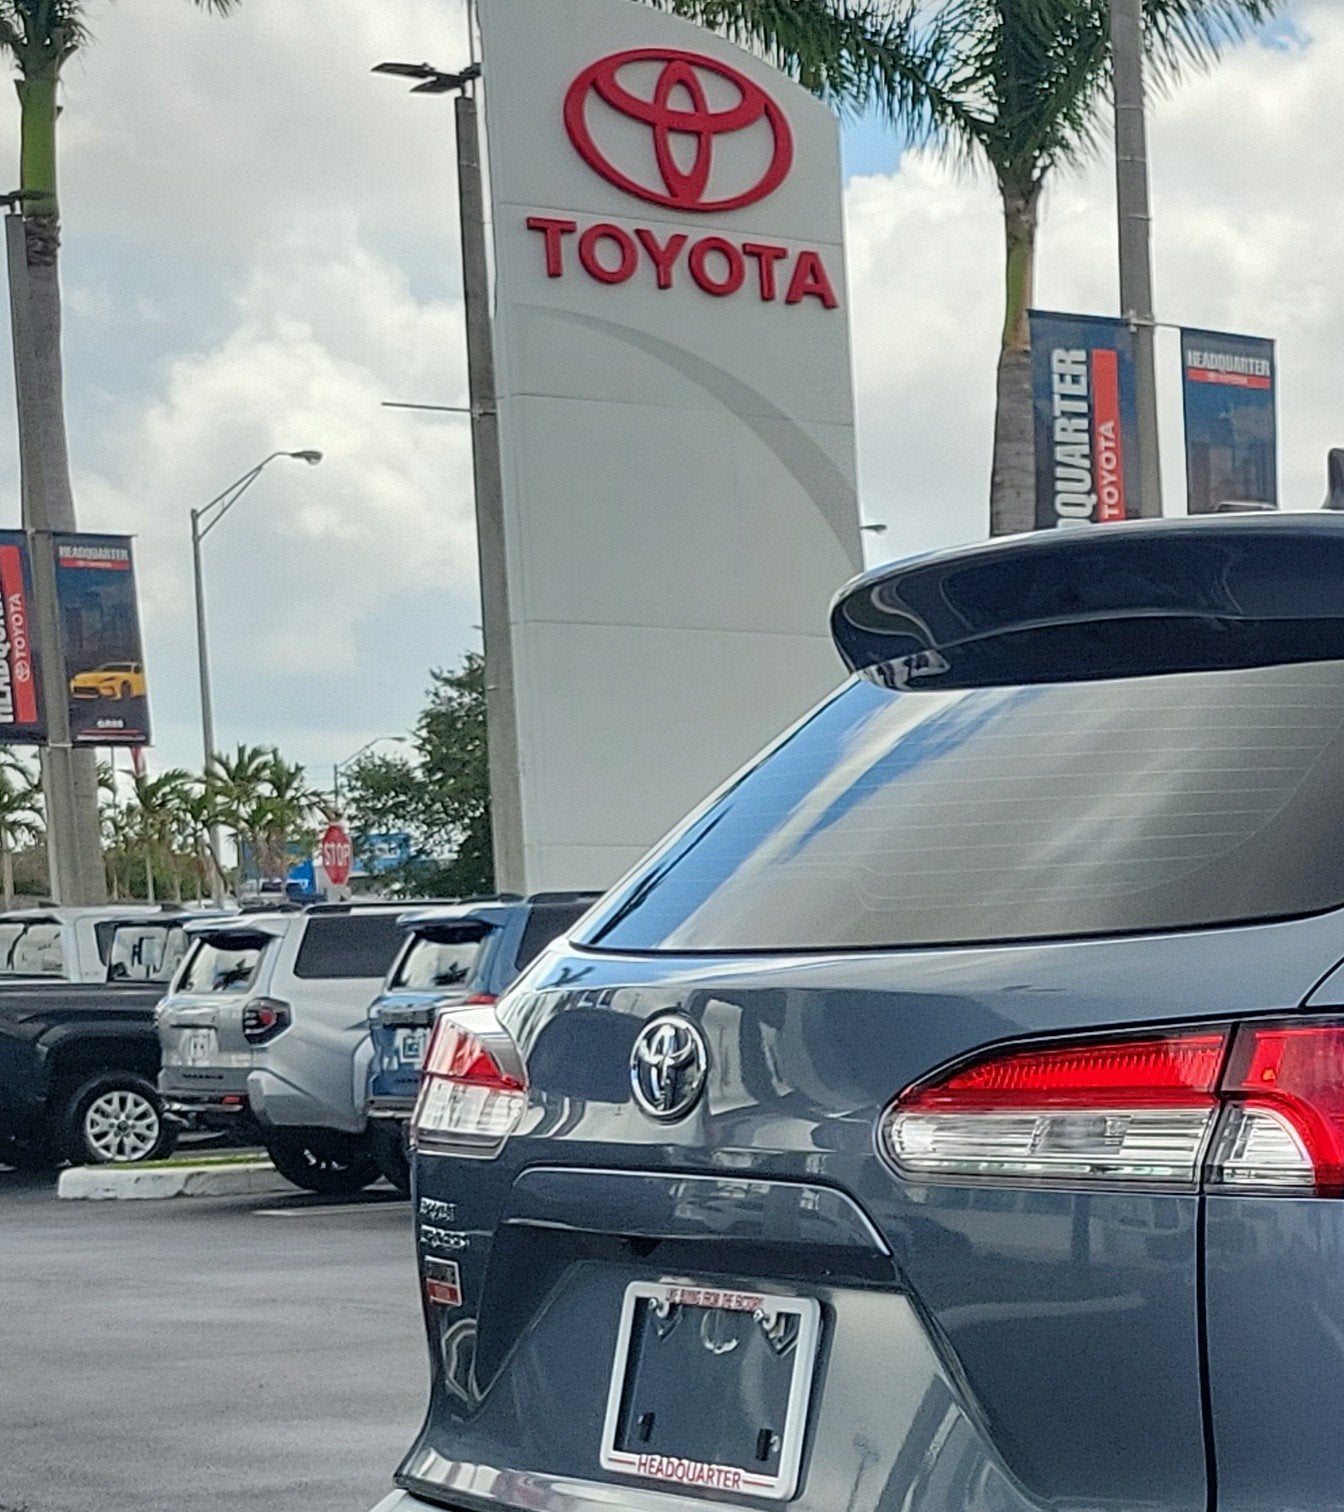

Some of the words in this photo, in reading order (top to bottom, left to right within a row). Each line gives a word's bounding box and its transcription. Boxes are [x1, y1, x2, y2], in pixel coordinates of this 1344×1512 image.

[526, 216, 839, 310] TOYOTA
[1187, 350, 1271, 377] HEADQUARTER
[1052, 349, 1099, 528] QUARTER
[1100, 420, 1120, 519] TOYOTA
[9, 593, 28, 659] TOYOTA
[324, 842, 351, 867] STOP
[636, 1454, 742, 1490] HEADQUARTER
